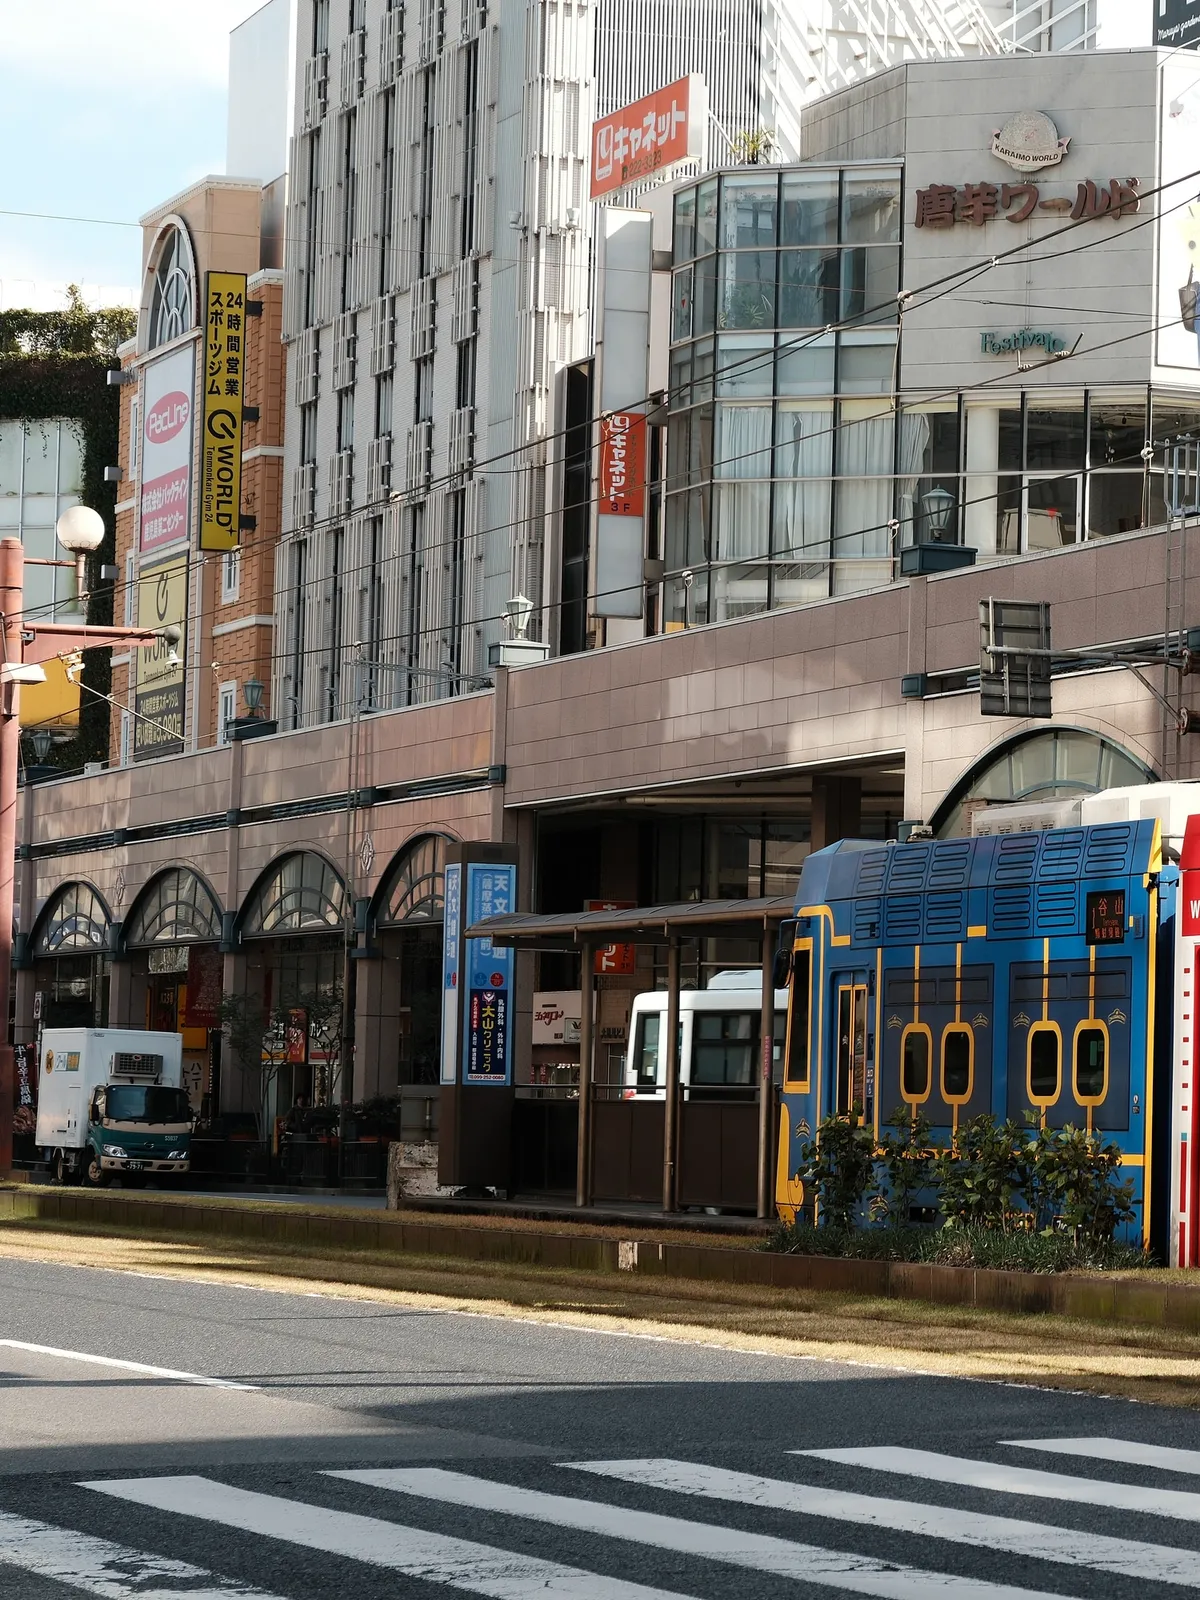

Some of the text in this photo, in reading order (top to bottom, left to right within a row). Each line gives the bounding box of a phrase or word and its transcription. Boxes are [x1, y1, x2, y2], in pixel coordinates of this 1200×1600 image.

[613, 99, 686, 165] キャネット
[994, 143, 1059, 162] KARAIMO WORLD
[914, 177, 1142, 229] 唐芋ワールド
[207, 291, 224, 396] スポーツジム
[225, 291, 244, 397] 24時間営業
[980, 329, 1066, 355] Festivalo
[204, 446, 215, 523] Tenmonkan Gym 24
[216, 444, 234, 527] WORLD
[609, 434, 627, 502] キャネット
[492, 875, 509, 959] 天文通
[481, 1005, 496, 1073] 大山クリニック
[191, 1062, 202, 1090] ハニー
